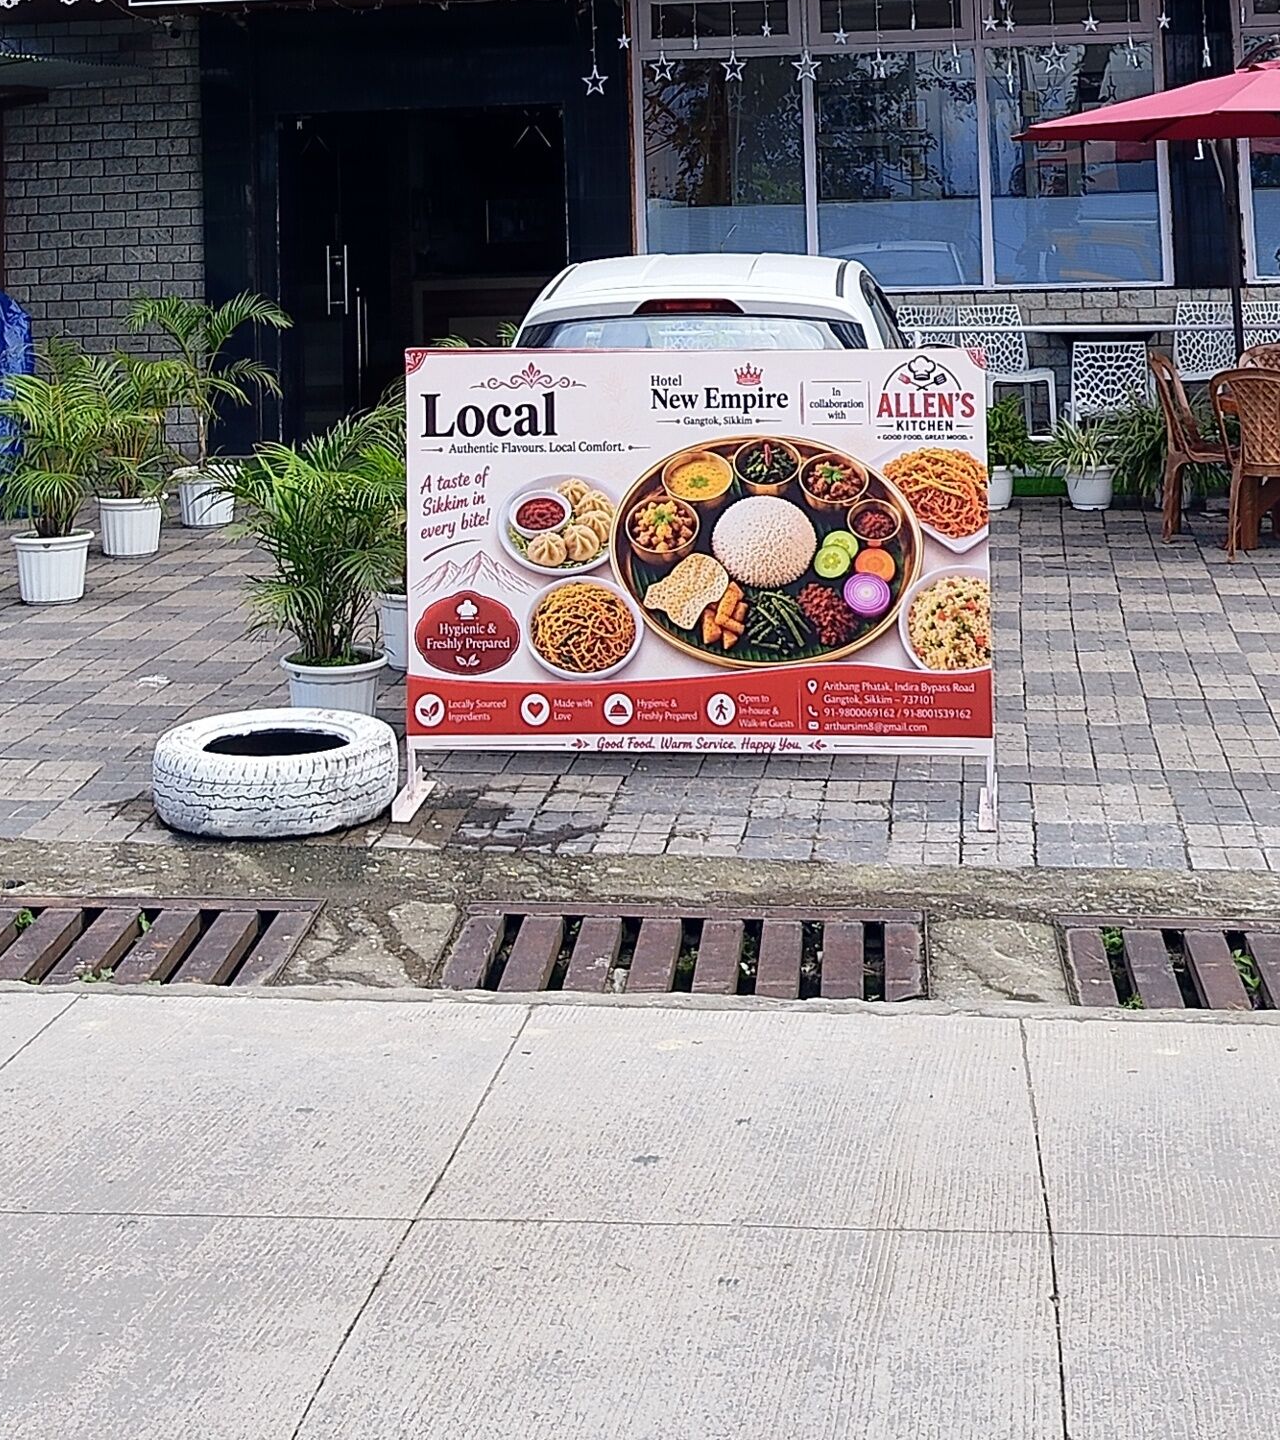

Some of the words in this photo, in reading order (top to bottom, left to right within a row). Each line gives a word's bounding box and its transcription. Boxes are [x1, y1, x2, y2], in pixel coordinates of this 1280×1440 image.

[650, 374, 683, 387] Hotel
[831, 387, 841, 397] In
[650, 388, 699, 410] New
[703, 387, 790, 414] Empire
[809, 398, 865, 409] collaboration
[419, 391, 559, 438] Local
[827, 410, 847, 420] with
[683, 416, 722, 427] Gangtok,
[724, 415, 754, 425] Sikkim
[896, 420, 954, 432] KITCHEN
[448, 443, 499, 454] Authentic
[501, 442, 547, 453] Flavours.
[549, 442, 576, 453] Local
[578, 441, 625, 453] Comfort.
[420, 474, 432, 495] A
[437, 472, 471, 491] taste
[474, 465, 490, 488] of
[422, 494, 469, 517] Sikkim
[473, 491, 486, 506] in
[420, 521, 456, 539] every
[461, 508, 491, 530] bite!
[439, 622, 485, 638] Hygienic
[486, 622, 497, 634] &
[426, 637, 463, 652] Freshly
[465, 637, 511, 651] Prepared
[823, 681, 860, 693] Arithang
[862, 681, 893, 692] Phatak,
[895, 682, 919, 692] Indira
[921, 683, 951, 694] Bypass
[953, 683, 975, 692] Road
[448, 699, 474, 711] Locally
[476, 699, 507, 709] Sourced
[554, 699, 576, 709] Made
[577, 699, 593, 709] with
[637, 699, 668, 712] Hygienic
[670, 699, 677, 709] &
[738, 694, 759, 705] Open
[761, 695, 769, 703] to
[823, 694, 862, 706] Gangtok,
[864, 694, 893, 704] Sikkim
[902, 695, 934, 704] 737101
[448, 712, 491, 723] Ingredients
[554, 711, 572, 722] Love
[637, 711, 663, 723] Freshly
[665, 711, 698, 724] Prepared
[823, 708, 895, 717] 91-9800069162
[903, 708, 971, 719] 91-8001539162
[739, 719, 767, 729] Walk-in
[769, 719, 795, 729] Guests
[596, 737, 624, 751] Good
[627, 737, 656, 750] Food.
[660, 737, 692, 750] Warm
[695, 737, 738, 750] Service.
[741, 737, 775, 753] Happy
[777, 737, 802, 751] You.
